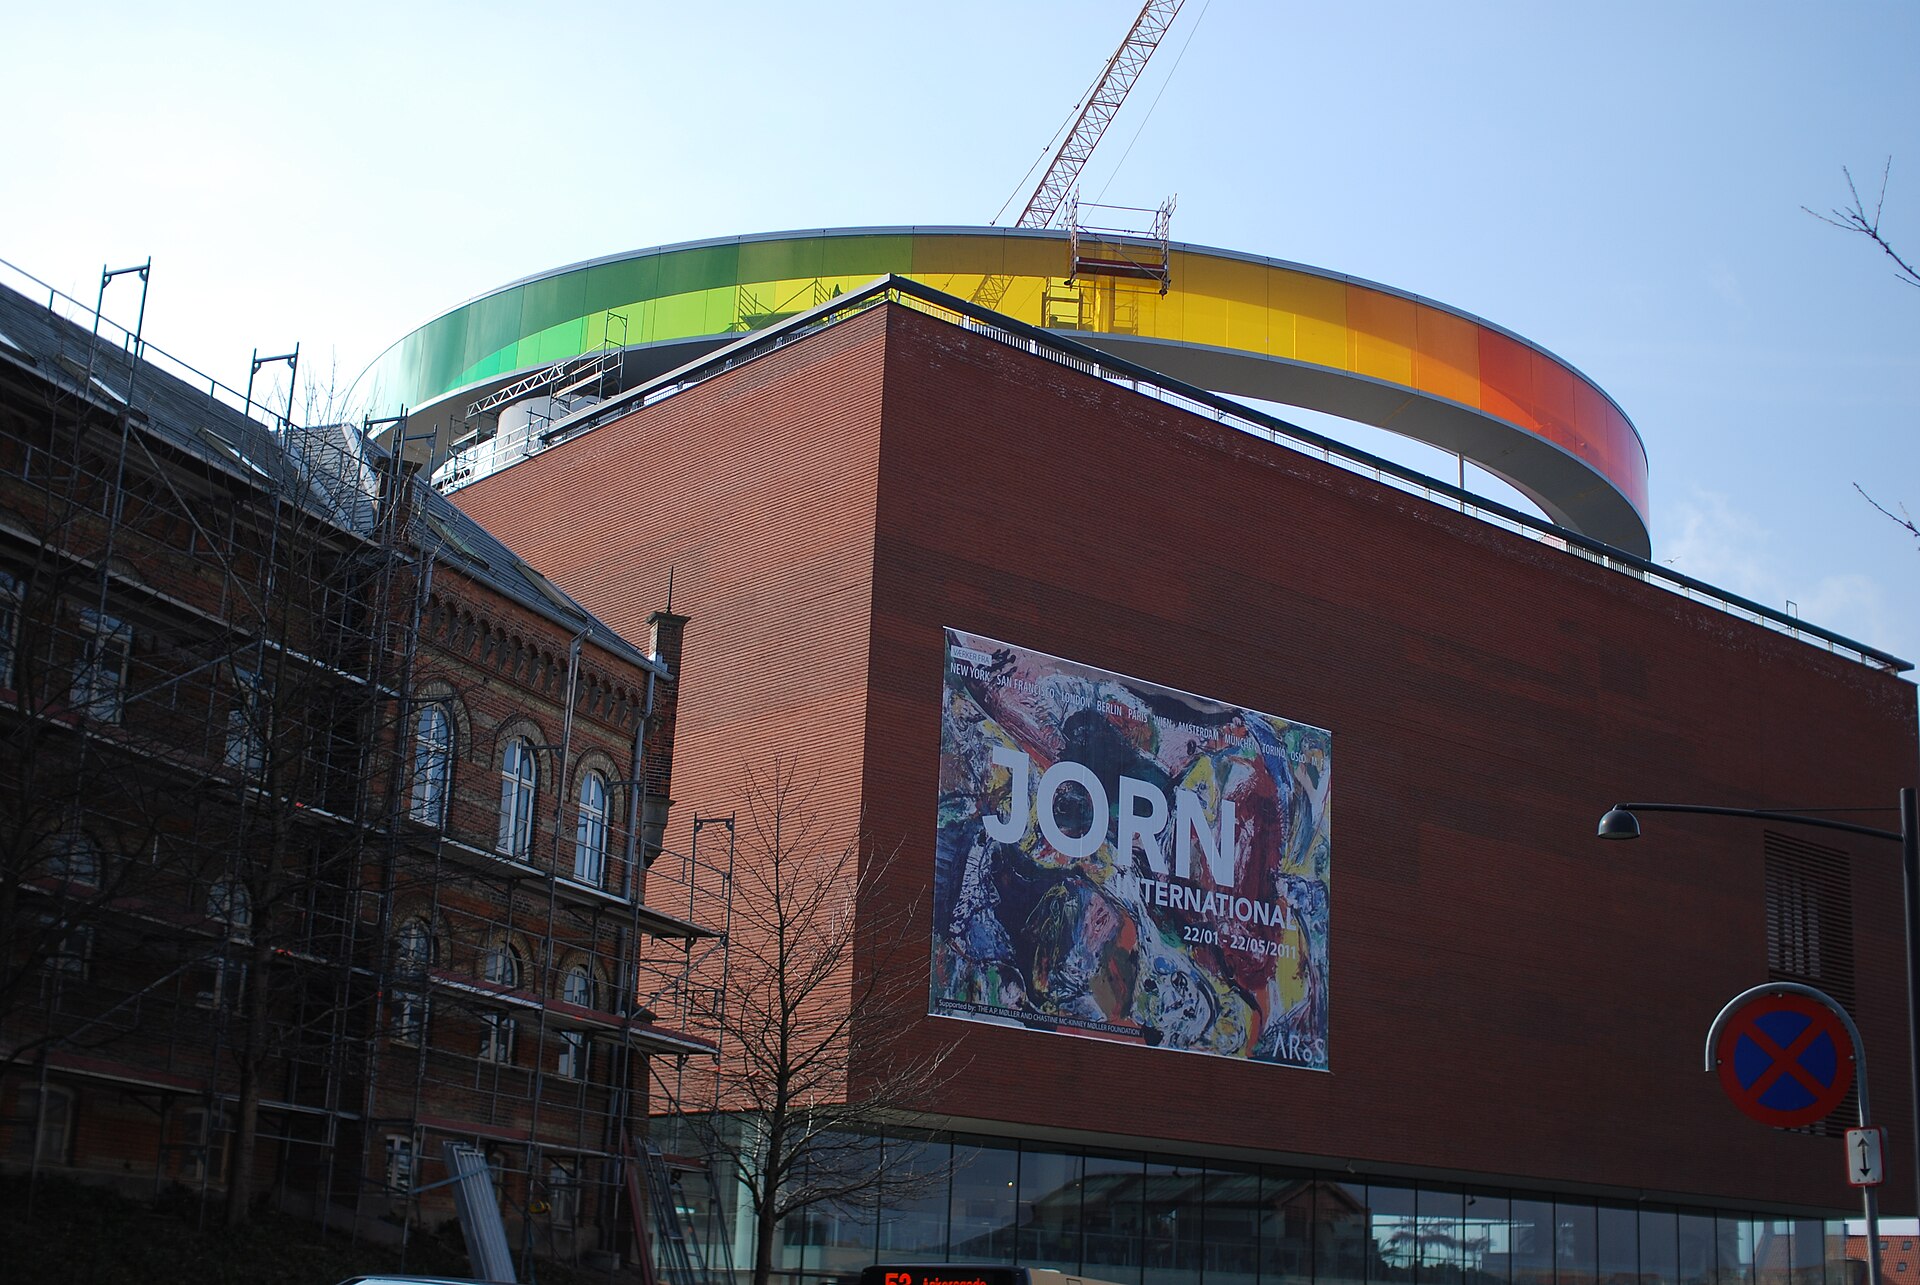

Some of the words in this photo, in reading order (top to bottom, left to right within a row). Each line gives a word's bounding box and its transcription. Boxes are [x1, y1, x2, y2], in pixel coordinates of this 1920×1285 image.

[950, 662, 969, 677] NEW
[969, 666, 990, 682] YORK
[996, 674, 1012, 688] SAN
[1014, 678, 1055, 699] FRANCISCO
[1061, 691, 1090, 708] LONDON
[1096, 700, 1122, 717] BERLIN
[1128, 708, 1148, 723] PARIS
[1153, 714, 1172, 728] WIEN
[1178, 721, 1219, 741] AMSTERDAM
[1262, 743, 1286, 758] TORINO
[1290, 751, 1306, 764] OSLO
[982, 746, 1236, 888] JORN
[1183, 926, 1219, 946] 22/01
[1230, 935, 1297, 960] 22/05/2011
[939, 999, 967, 1010] Supported
[967, 1003, 976, 1012] by:
[978, 1005, 988, 1013] THE
[1021, 1012, 1032, 1020] AND
[1033, 1013, 1058, 1024] CHASTINE
[1108, 1026, 1140, 1036] FOUNDATION
